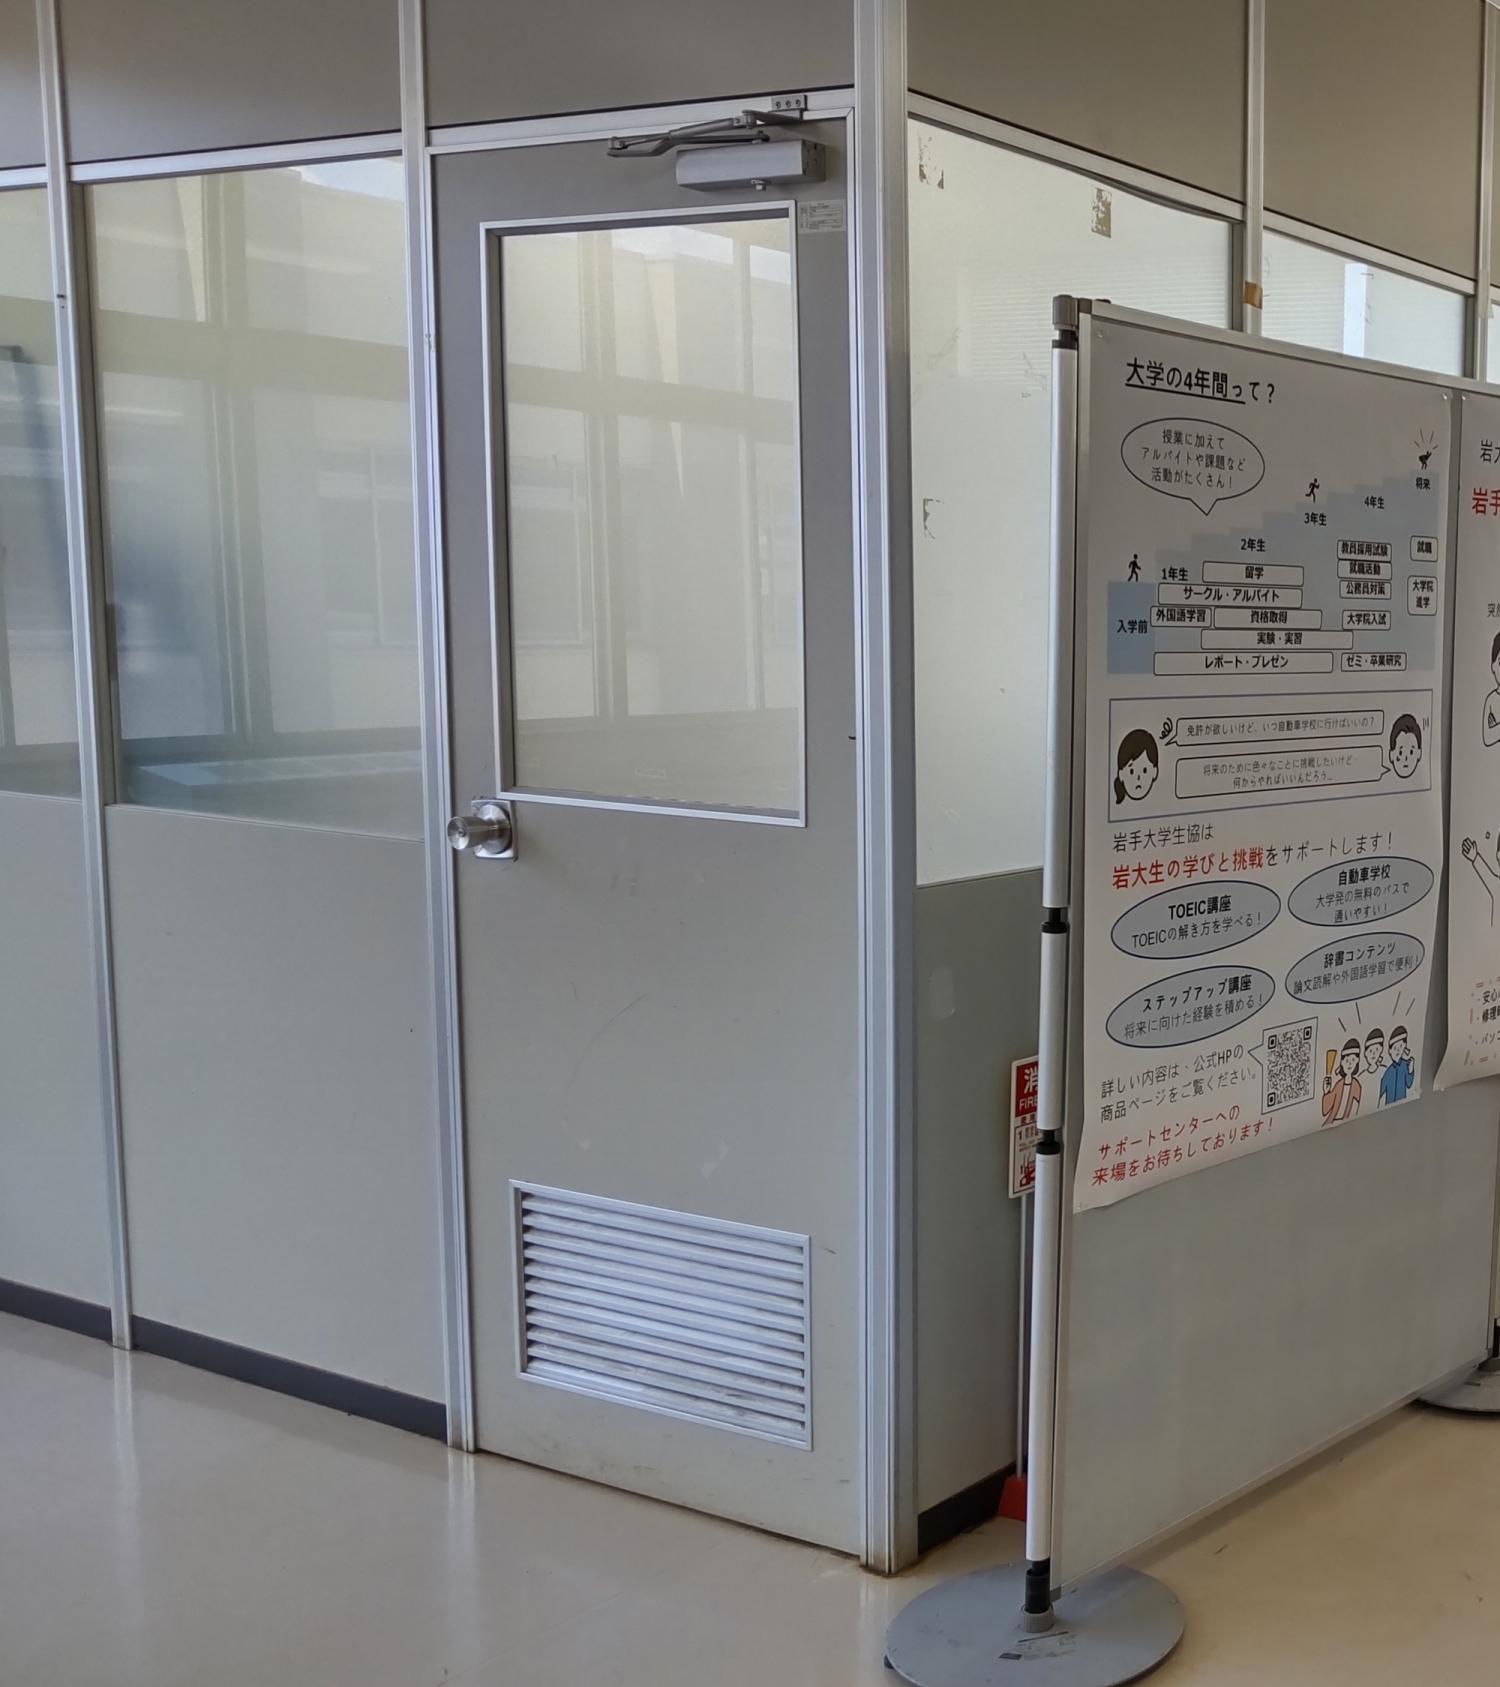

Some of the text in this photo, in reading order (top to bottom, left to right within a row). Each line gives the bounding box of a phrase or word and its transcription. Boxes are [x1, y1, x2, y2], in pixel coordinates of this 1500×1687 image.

[1126, 358, 1275, 403] 大学の4年間って？
[1162, 428, 1225, 451] 授業に加えて
[1141, 446, 1246, 472] アルバイトや課題など
[1151, 467, 1233, 490] 活動がたくさん！
[1415, 476, 1431, 491] 将来
[1364, 495, 1385, 511] 4年生
[1304, 511, 1328, 527] 3年生
[1240, 538, 1266, 553] 2年生
[1341, 542, 1389, 558] 教員採用試験
[1416, 540, 1433, 555] 就職
[1161, 566, 1189, 582] 1年生
[1244, 565, 1264, 580] 留学
[1349, 562, 1381, 577] 就職活動
[1183, 586, 1280, 603] サークル・アルバイト
[1345, 581, 1386, 597] 公務員対策
[1412, 579, 1434, 594] 大学院
[1415, 596, 1430, 610] 進学
[1156, 608, 1207, 624] 外国語学習
[1250, 609, 1288, 625] 資格取得
[1346, 612, 1387, 627] 大学院入試
[1116, 619, 1148, 635] 入学前
[1256, 631, 1303, 646] 実験・実習
[1204, 655, 1289, 670] レポート・プレゼン
[1346, 653, 1402, 669] ゼミ・卒業研究
[1112, 823, 1214, 853] 岩手大学生協は
[1112, 832, 1393, 890] 岩大生の学びと挑戦をサポートします！
[1338, 864, 1391, 887] 自動車学校
[1315, 881, 1409, 909] 大学発の無料のバスで
[1168, 894, 1232, 919] TOEIC講座
[1334, 902, 1389, 925] 通いやすい！
[1132, 912, 1261, 950] TOEICの解き方を学べる！
[1324, 941, 1396, 970] 辞書コンテンツ
[1142, 974, 1252, 1012] ステップアップ講座
[1124, 992, 1262, 1041] 将来に向けた経験を積める！
[1100, 1066, 1258, 1124] 商品ページをご覧ください。
[1098, 1105, 1240, 1158] サポートセンターへの
[1092, 1119, 1273, 1187] 来場をお待ちしております！
